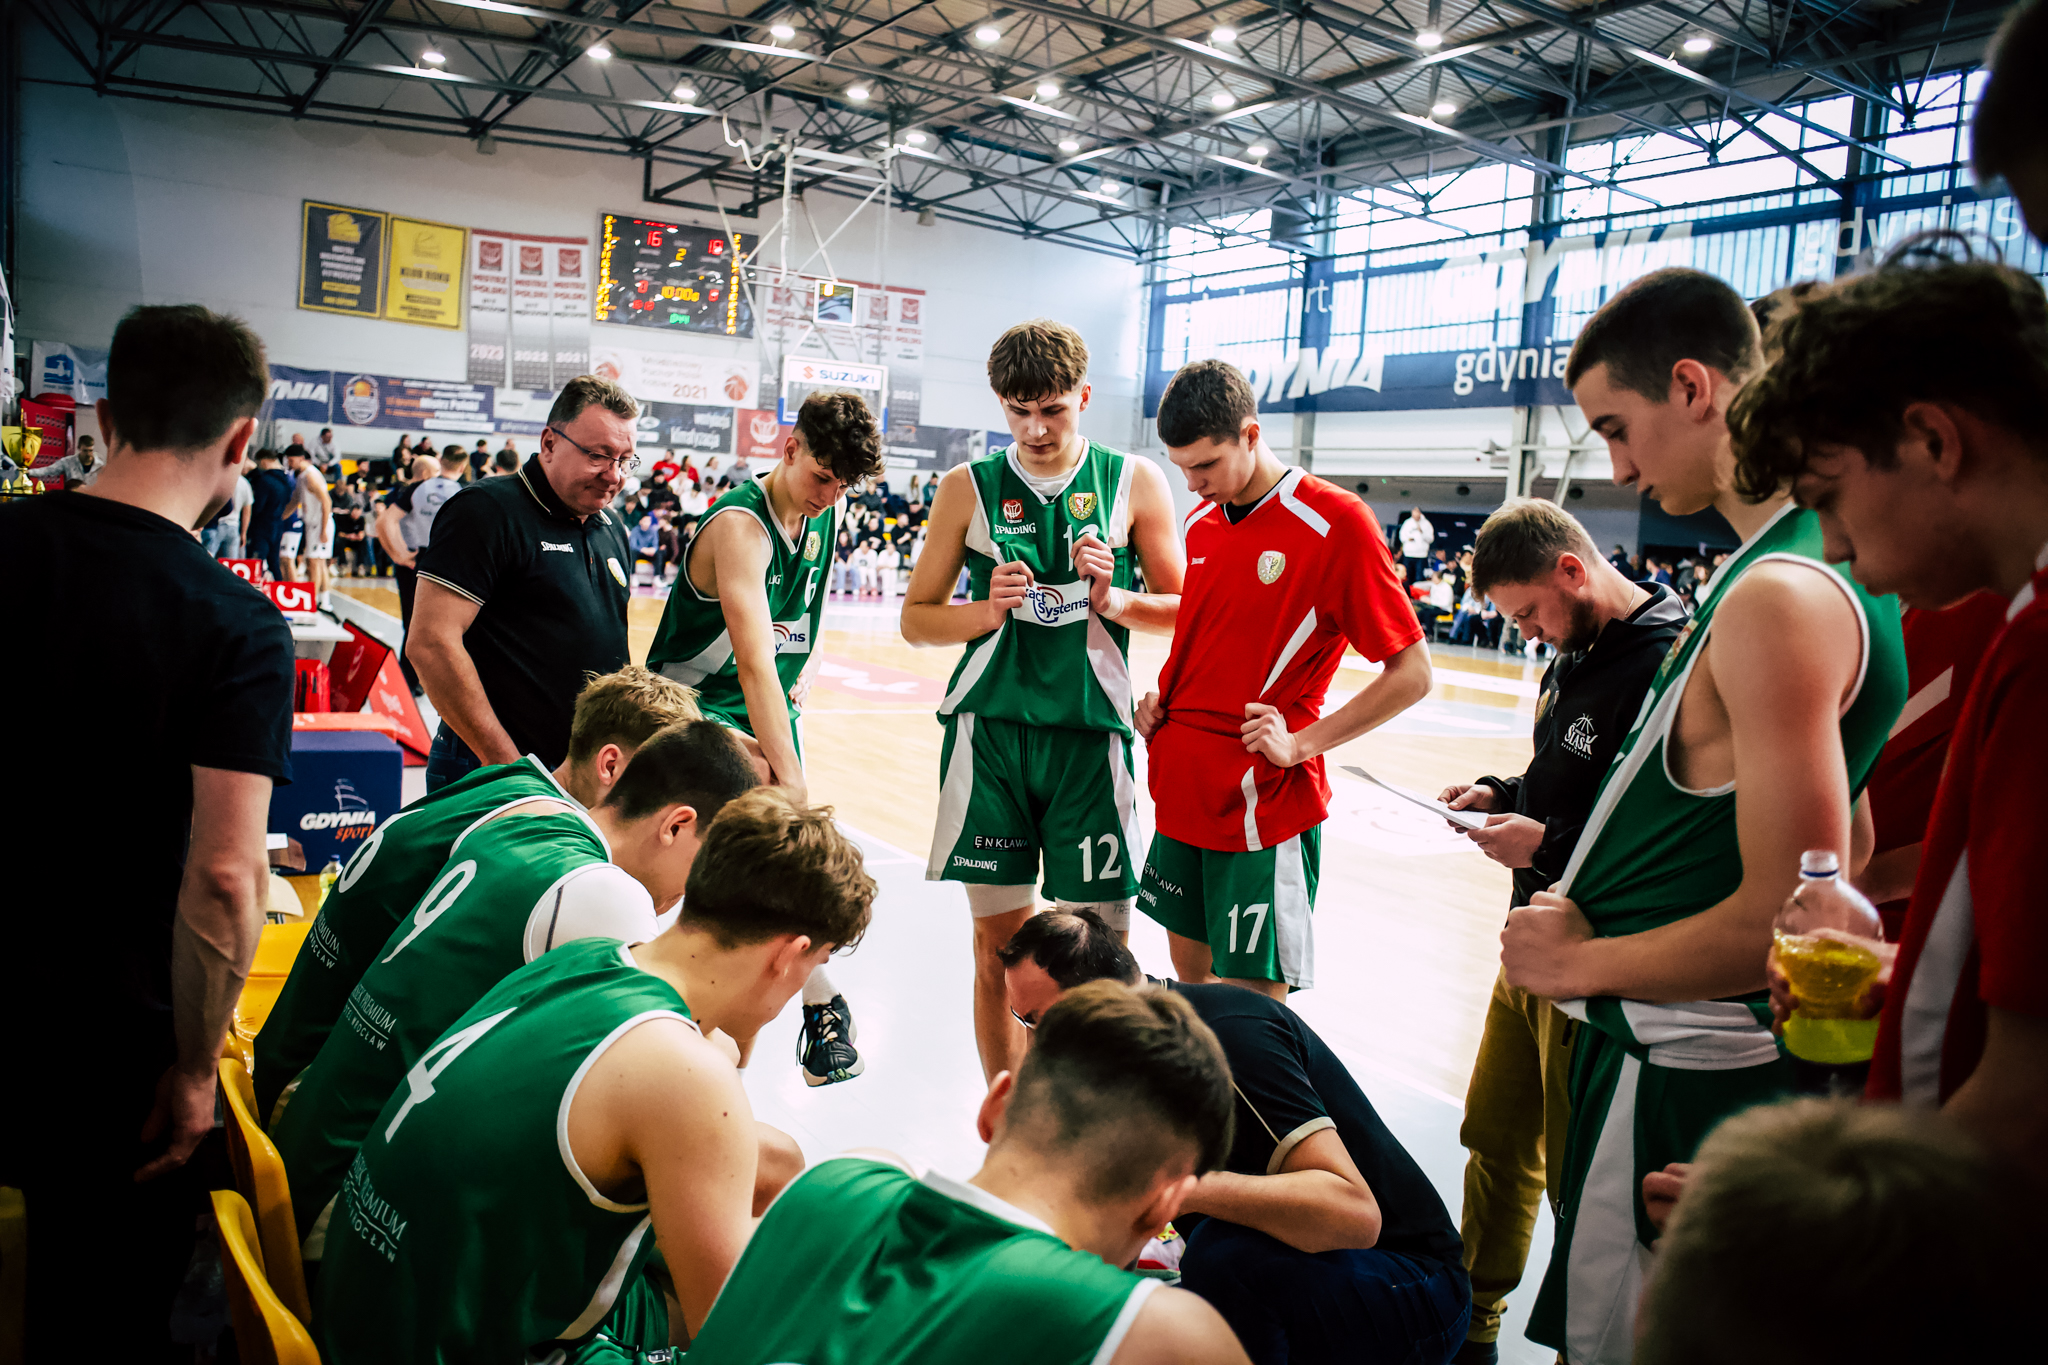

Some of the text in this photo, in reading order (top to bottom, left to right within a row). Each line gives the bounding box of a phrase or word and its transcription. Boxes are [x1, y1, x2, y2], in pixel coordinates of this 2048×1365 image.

[647, 231, 663, 247] 16
[676, 248, 687, 261] 2
[819, 370, 875, 384] SUZUKI
[1244, 346, 1385, 404] DYNIA
[268, 379, 329, 403] YNIA
[672, 384, 708, 399] 2021
[994, 522, 1037, 534] SPALDING
[540, 541, 574, 553] SPALDING
[1025, 588, 1047, 604] xact
[1038, 598, 1089, 618] Systems
[299, 811, 376, 831] GDYNIA
[335, 824, 375, 843] sport
[953, 855, 998, 872] SPALDING
[1078, 833, 1122, 882] 12
[380, 859, 478, 964] 9
[1227, 903, 1270, 954] 17
[385, 1006, 518, 1143] 4
